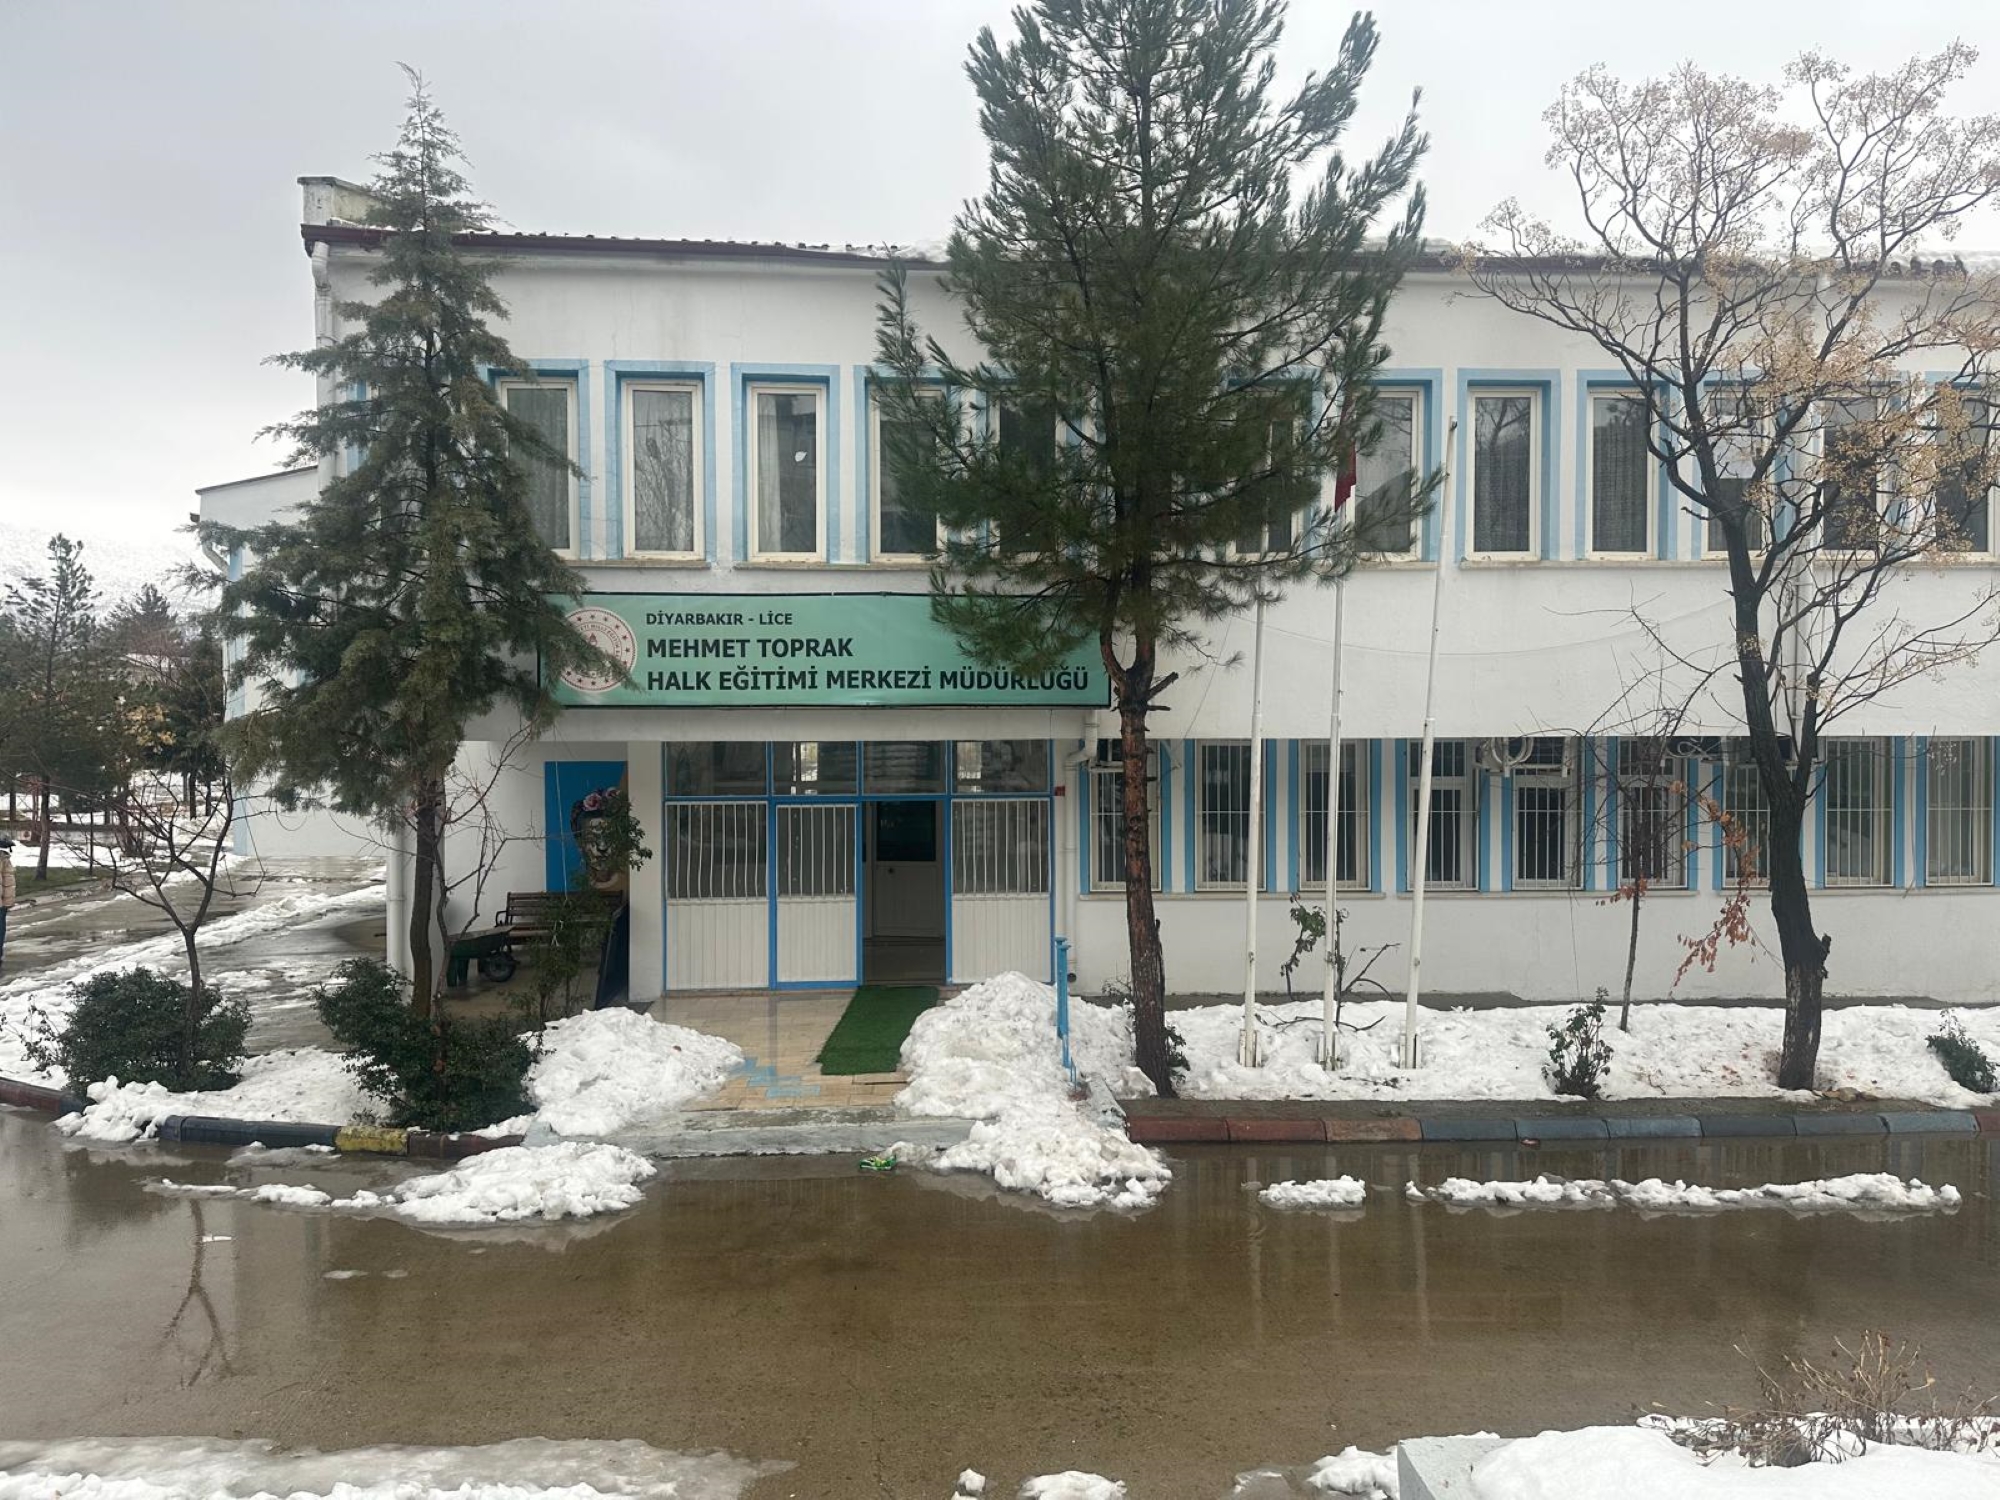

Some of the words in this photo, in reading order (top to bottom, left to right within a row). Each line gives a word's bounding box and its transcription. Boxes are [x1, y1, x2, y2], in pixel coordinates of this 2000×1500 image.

[646, 610, 744, 625] DİYARBAKIR
[759, 610, 793, 625] LİCE
[647, 638, 751, 658] MEHMET
[756, 637, 854, 658] TOPRAK
[647, 671, 712, 691] HALK
[719, 665, 818, 691] EĞİTİMİ
[826, 665, 932, 689] MERKEZİ
[939, 664, 1090, 691] MÜDÜRLÜĞÜ
